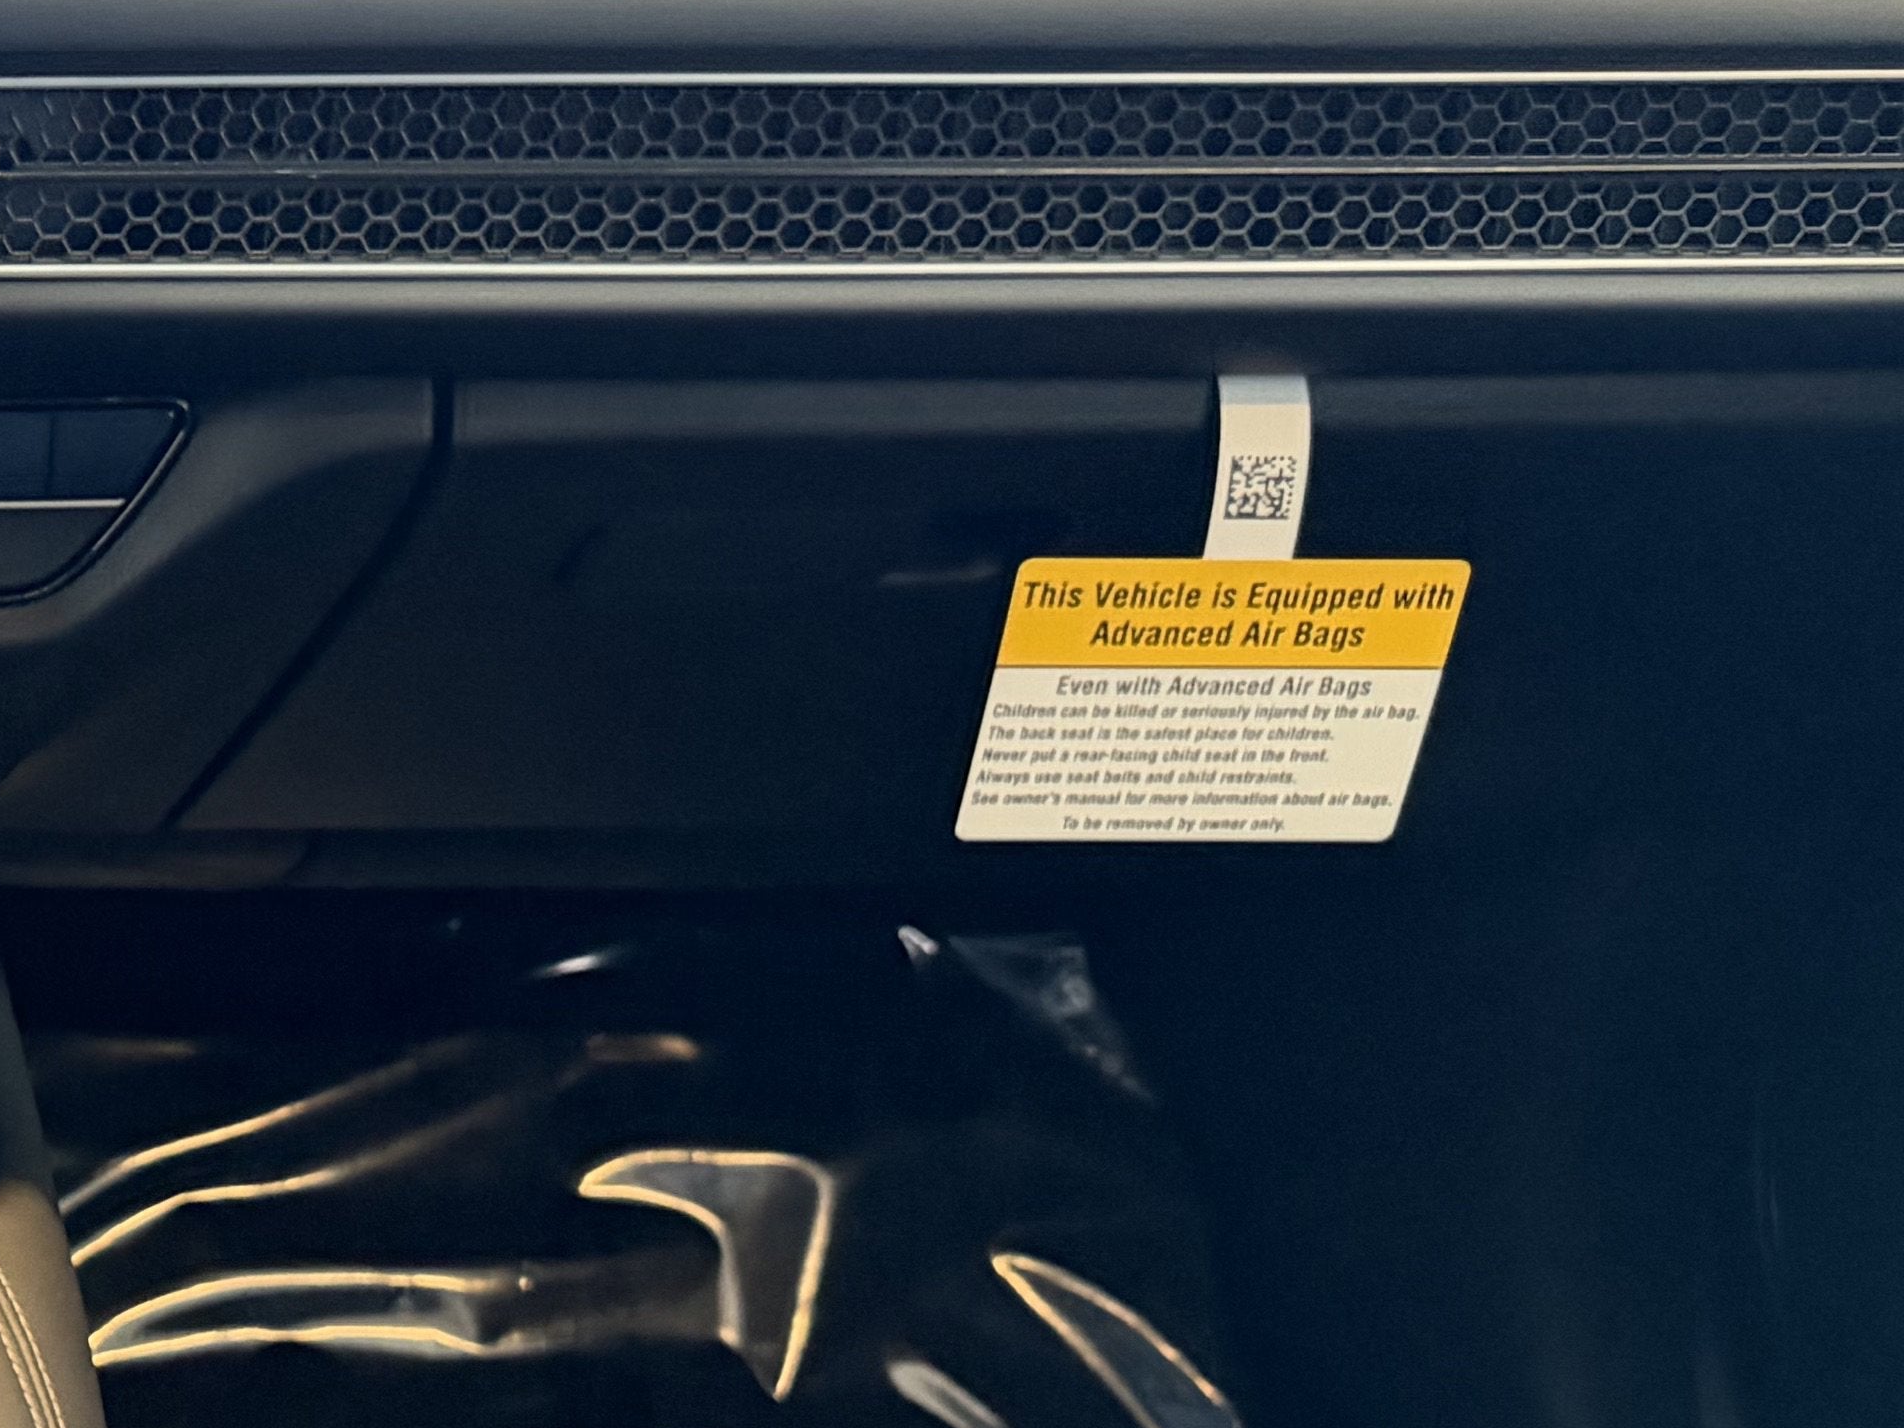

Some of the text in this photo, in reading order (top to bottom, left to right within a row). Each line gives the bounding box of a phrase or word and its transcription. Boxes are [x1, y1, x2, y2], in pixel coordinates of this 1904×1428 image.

[1024, 582, 1454, 615] This Vehicle is Equipped with
[1090, 621, 1365, 651] Advanced Air Bags
[1056, 675, 1372, 699] Even with Advanced Air Bags
[993, 704, 1419, 721] Children can be killed or seriously injured by the air bag.
[989, 726, 1334, 743] The back seat is the safest place for children.
[982, 748, 1328, 764] Never put a rear-facing child seat in the front.
[976, 770, 1030, 785] Always
[1034, 773, 1061, 783] use
[1066, 771, 1100, 784] seat
[1103, 771, 1141, 784] belts
[1146, 772, 1174, 784] and
[1178, 772, 1216, 784] child
[972, 792, 998, 805] See
[1065, 792, 1120, 805] manual
[1124, 792, 1145, 805] for
[1149, 794, 1187, 805] more
[1193, 793, 1277, 805] information
[1282, 793, 1324, 806] about
[1328, 794, 1348, 806] air
[1062, 817, 1078, 829] To
[1083, 817, 1101, 830] be
[1106, 817, 1174, 830] removed
[1177, 818, 1195, 832] by
[1199, 821, 1246, 831] owner
